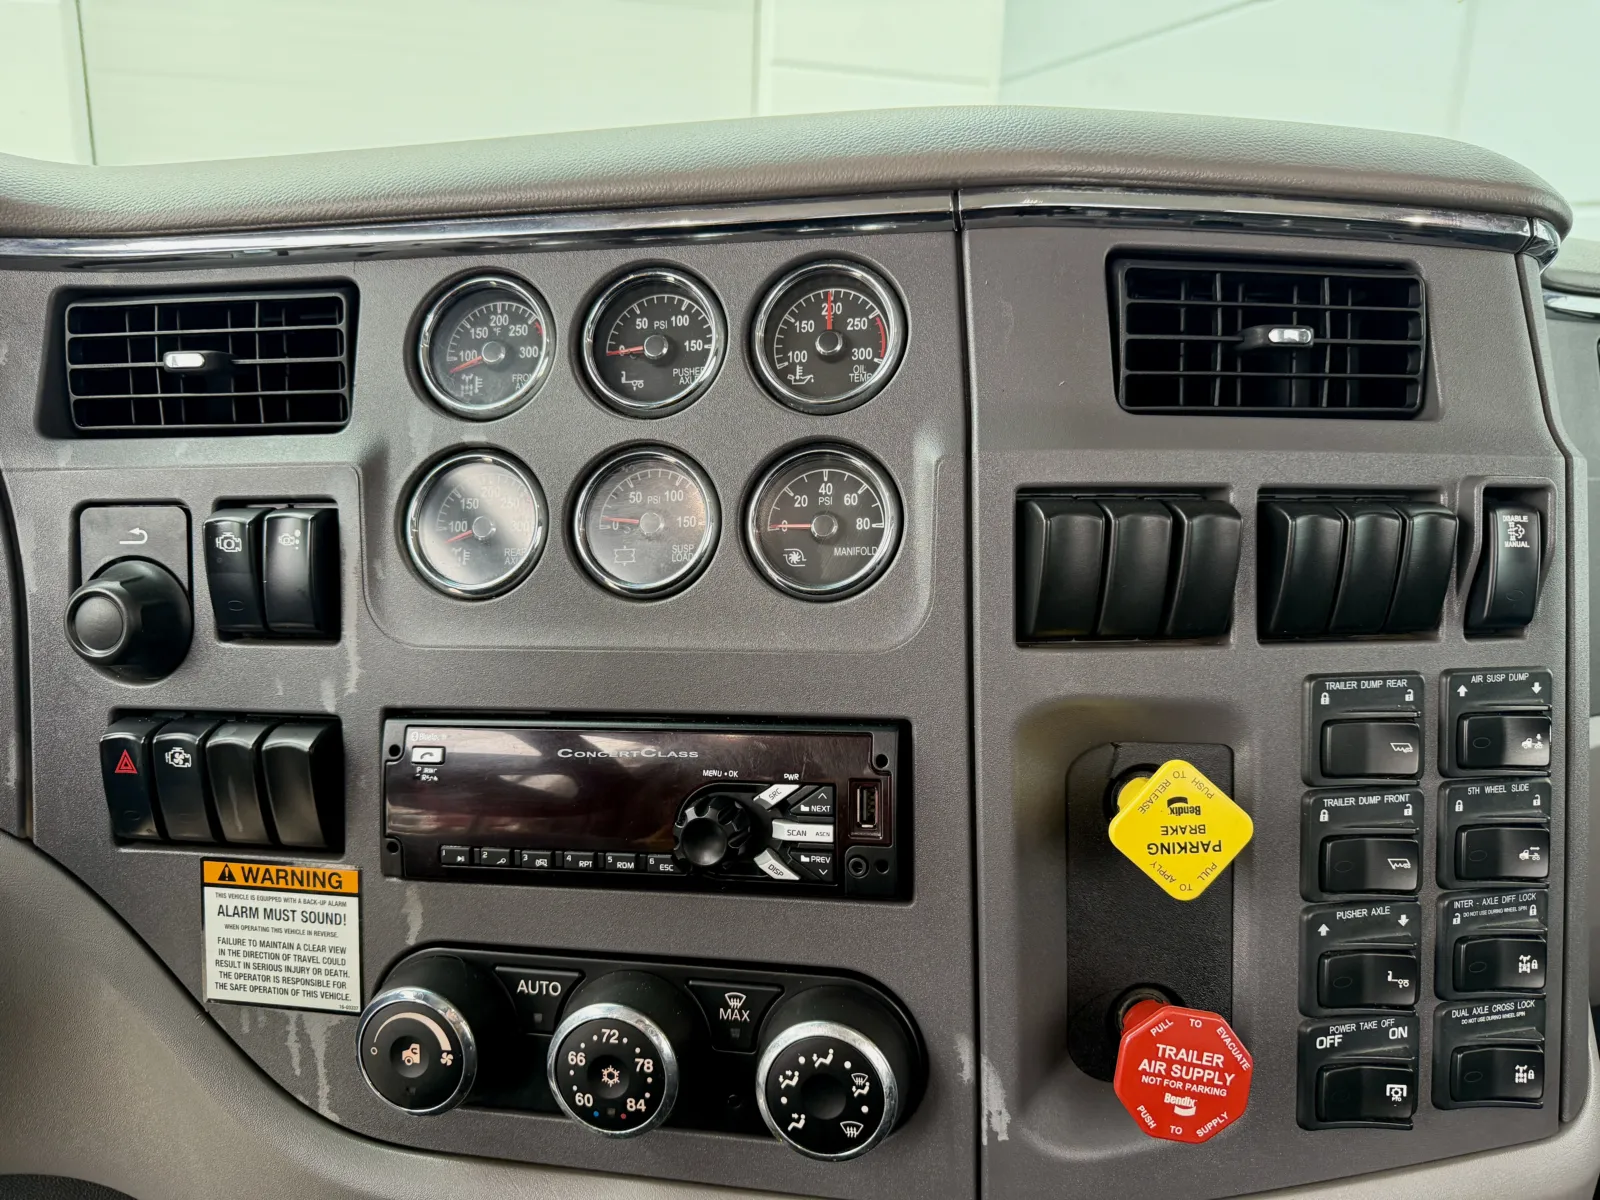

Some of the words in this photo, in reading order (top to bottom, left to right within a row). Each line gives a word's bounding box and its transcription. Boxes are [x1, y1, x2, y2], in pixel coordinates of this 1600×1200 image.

[490, 315, 509, 326] 200
[636, 318, 648, 329] 50
[654, 321, 667, 329] PSI
[671, 315, 689, 326] 100
[795, 320, 814, 332] 150
[847, 318, 868, 330] 250
[470, 327, 488, 339] 150
[509, 325, 528, 336] 250
[684, 340, 703, 351] 150
[460, 350, 477, 361] 100
[520, 347, 538, 358] 300
[788, 351, 807, 362] 100
[852, 348, 873, 360] 300
[853, 365, 866, 373] OIL
[819, 483, 833, 495] 40
[629, 492, 642, 503] 50
[665, 490, 684, 501] 100
[794, 495, 808, 507] 20
[818, 497, 832, 505] PSI
[844, 493, 858, 505] 60
[460, 498, 478, 509] 150
[449, 521, 467, 532] 100
[613, 521, 618, 530] 0
[677, 516, 696, 528] 150
[856, 518, 870, 530] 80
[672, 545, 694, 554] SUSP
[834, 547, 878, 556] MANIFOLD
[1471, 675, 1483, 683] AIR
[1487, 674, 1505, 682] SUSP
[1509, 673, 1529, 681] DUMP
[1325, 682, 1357, 690] TRAILER
[1361, 680, 1382, 689] DUMP
[1387, 679, 1407, 687] REAR
[769, 788, 782, 800] SRC
[1192, 778, 1215, 799] PUSH
[1468, 787, 1480, 795] 5TH
[1485, 785, 1506, 793] WHEEL
[1511, 783, 1529, 792] SLIDE
[1138, 779, 1171, 814] RELEASE
[1323, 798, 1355, 807] TRAILER
[1359, 796, 1381, 805] DUMP
[1384, 794, 1410, 803] FRONT
[1170, 806, 1201, 816] Bendix
[787, 829, 807, 837] SCAN
[1161, 825, 1206, 835] BRAKE
[1147, 840, 1221, 855] PARKING
[811, 856, 830, 864] PREV
[768, 864, 784, 877] DISP
[1150, 861, 1176, 883] APPLY
[1197, 862, 1217, 881] PULL
[241, 866, 342, 889] WARNING
[1454, 900, 1473, 908] INTER
[1482, 897, 1498, 905] AXLE
[1502, 895, 1516, 903] DIFF
[1519, 893, 1536, 901] LOCK
[217, 905, 259, 919] ALARM
[264, 908, 297, 922] MUST
[301, 911, 346, 925] SOUND!
[1337, 909, 1368, 920] PUSHER
[1371, 906, 1390, 916] AXLE
[314, 930, 338, 938] REVERSE.
[217, 937, 246, 946] FAILURE
[248, 939, 257, 947] TO
[259, 940, 294, 949] MAINTAIN
[303, 944, 326, 952] CLEAR
[328, 946, 346, 954] VIEW
[243, 951, 280, 960] DIRECTION
[293, 955, 320, 963] TRAVEL
[323, 957, 346, 966] COULD
[215, 960, 241, 969] RESULT
[252, 963, 282, 972] SERIOUS
[285, 966, 310, 975] INJURY
[325, 969, 350, 978] DEATH.
[219, 971, 232, 979] THE
[234, 972, 271, 983] OPERATOR
[273, 975, 280, 983] IS
[282, 976, 330, 988] RESPONSIBLE
[333, 980, 346, 988] FOR
[215, 982, 228, 990] THE
[230, 983, 247, 991] SAFE
[250, 985, 288, 995] OPERATION
[291, 988, 300, 996] OF
[302, 990, 318, 998] THIS
[320, 991, 351, 1001] VEHICLE.
[517, 980, 561, 995] AUTO
[719, 1008, 750, 1021] MAX
[1452, 1009, 1469, 1018] DUAL
[1472, 1006, 1489, 1015] AXLE
[1492, 1003, 1515, 1012] CROSS
[1518, 1000, 1536, 1009] LOCK
[1330, 1024, 1356, 1034] POWER
[1360, 1021, 1377, 1030] TAKE
[1381, 1019, 1395, 1027] OFF
[1389, 1026, 1408, 1039] ON
[602, 1029, 619, 1043] 72
[1316, 1035, 1343, 1049] OFF
[1150, 1019, 1173, 1036] PULL
[1189, 1019, 1202, 1028] TO
[1216, 1027, 1250, 1071] EVACUATE
[568, 1051, 585, 1065] 66
[1156, 1044, 1224, 1068] TRAILER
[635, 1059, 653, 1072] 78
[1138, 1059, 1166, 1075] AIR
[1171, 1064, 1235, 1086] SUPPLY
[1142, 1075, 1162, 1085] NOT
[1163, 1079, 1183, 1089] FOR
[1185, 1083, 1227, 1096] PARKING
[575, 1093, 593, 1106] 60
[627, 1098, 646, 1112] 84
[1164, 1093, 1195, 1107] Bendix
[1137, 1105, 1157, 1128] PUSH
[1170, 1125, 1182, 1134] TO
[1196, 1112, 1228, 1137] SUPPLY
